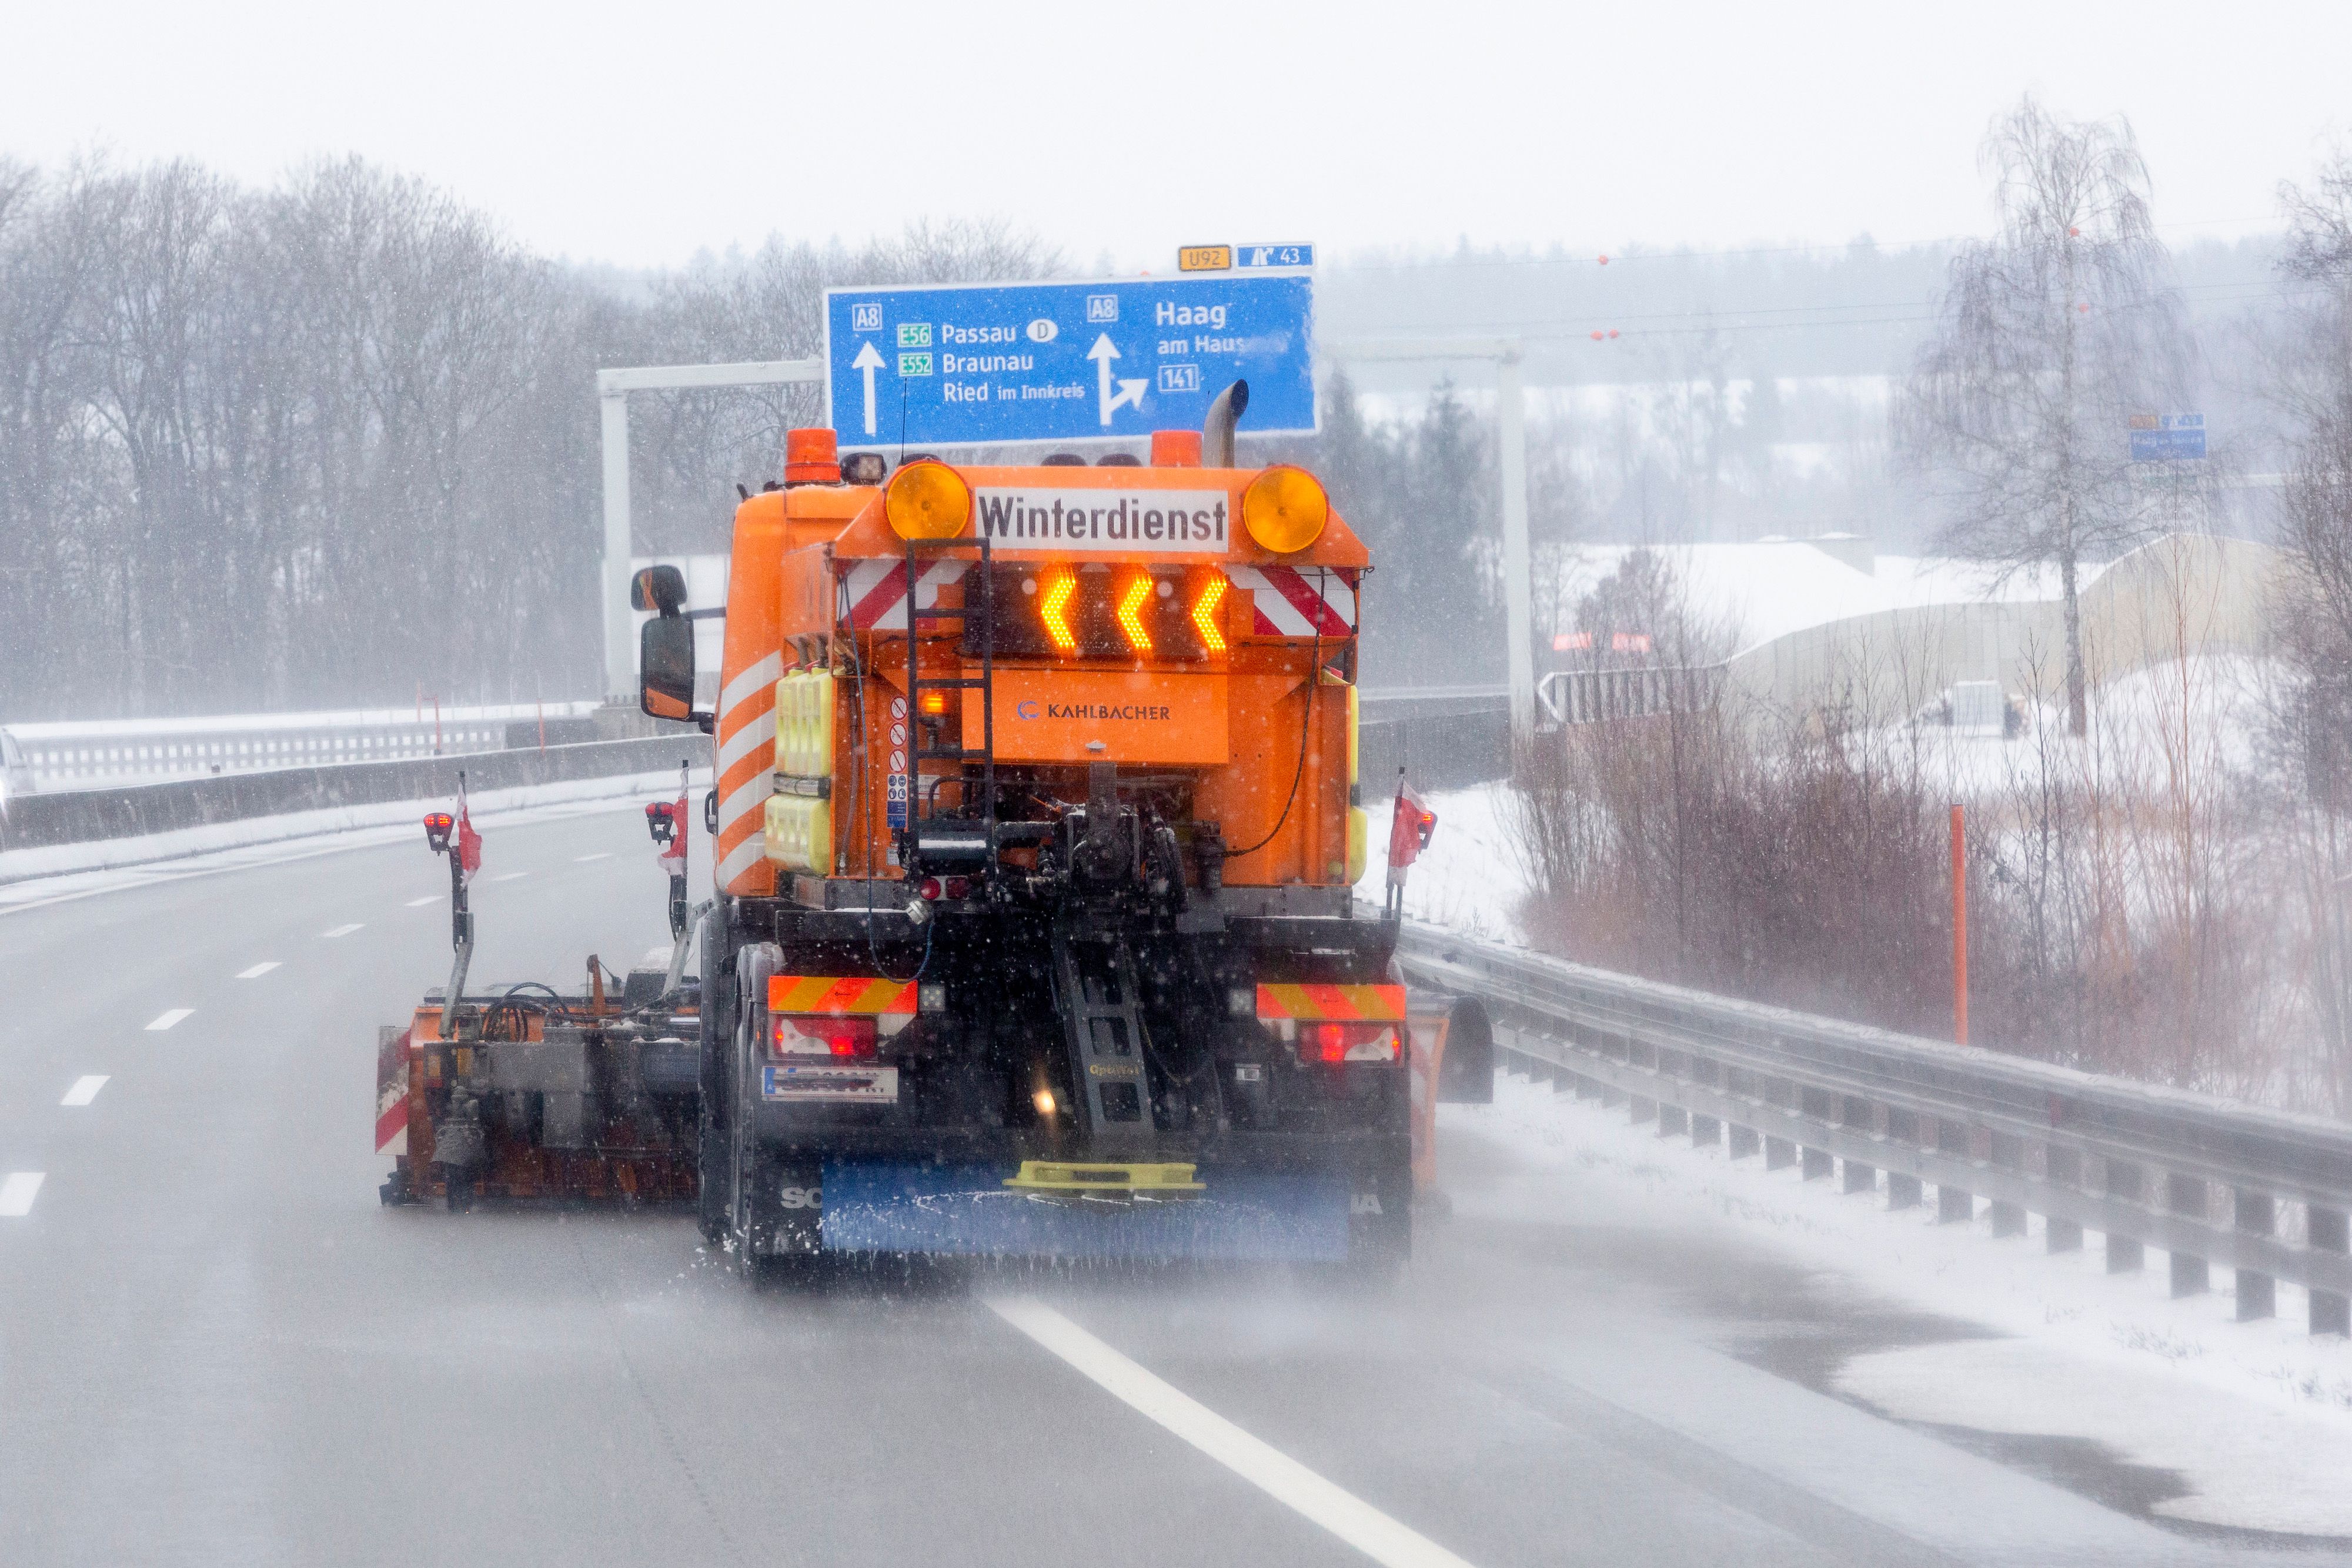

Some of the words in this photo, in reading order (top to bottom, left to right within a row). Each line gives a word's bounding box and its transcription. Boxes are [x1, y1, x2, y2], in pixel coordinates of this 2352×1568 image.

[1189, 250, 1220, 266] U92
[1280, 248, 1300, 263] 43
[856, 306, 879, 327] A8
[1091, 298, 1114, 319] A8
[1156, 302, 1227, 330] Haag
[900, 326, 930, 345] E56
[942, 323, 1016, 345] Passau
[1037, 322, 1048, 339] D
[1157, 339, 1188, 354] am
[901, 356, 931, 374] E552
[943, 353, 1033, 373] Braunau
[1164, 368, 1194, 389] 141
[944, 382, 988, 402] Ried
[998, 386, 1016, 400] im
[1022, 381, 1085, 399] Innkreis
[978, 496, 1226, 540] Winterdienst
[1048, 704, 1171, 720] KAHLBACHER
